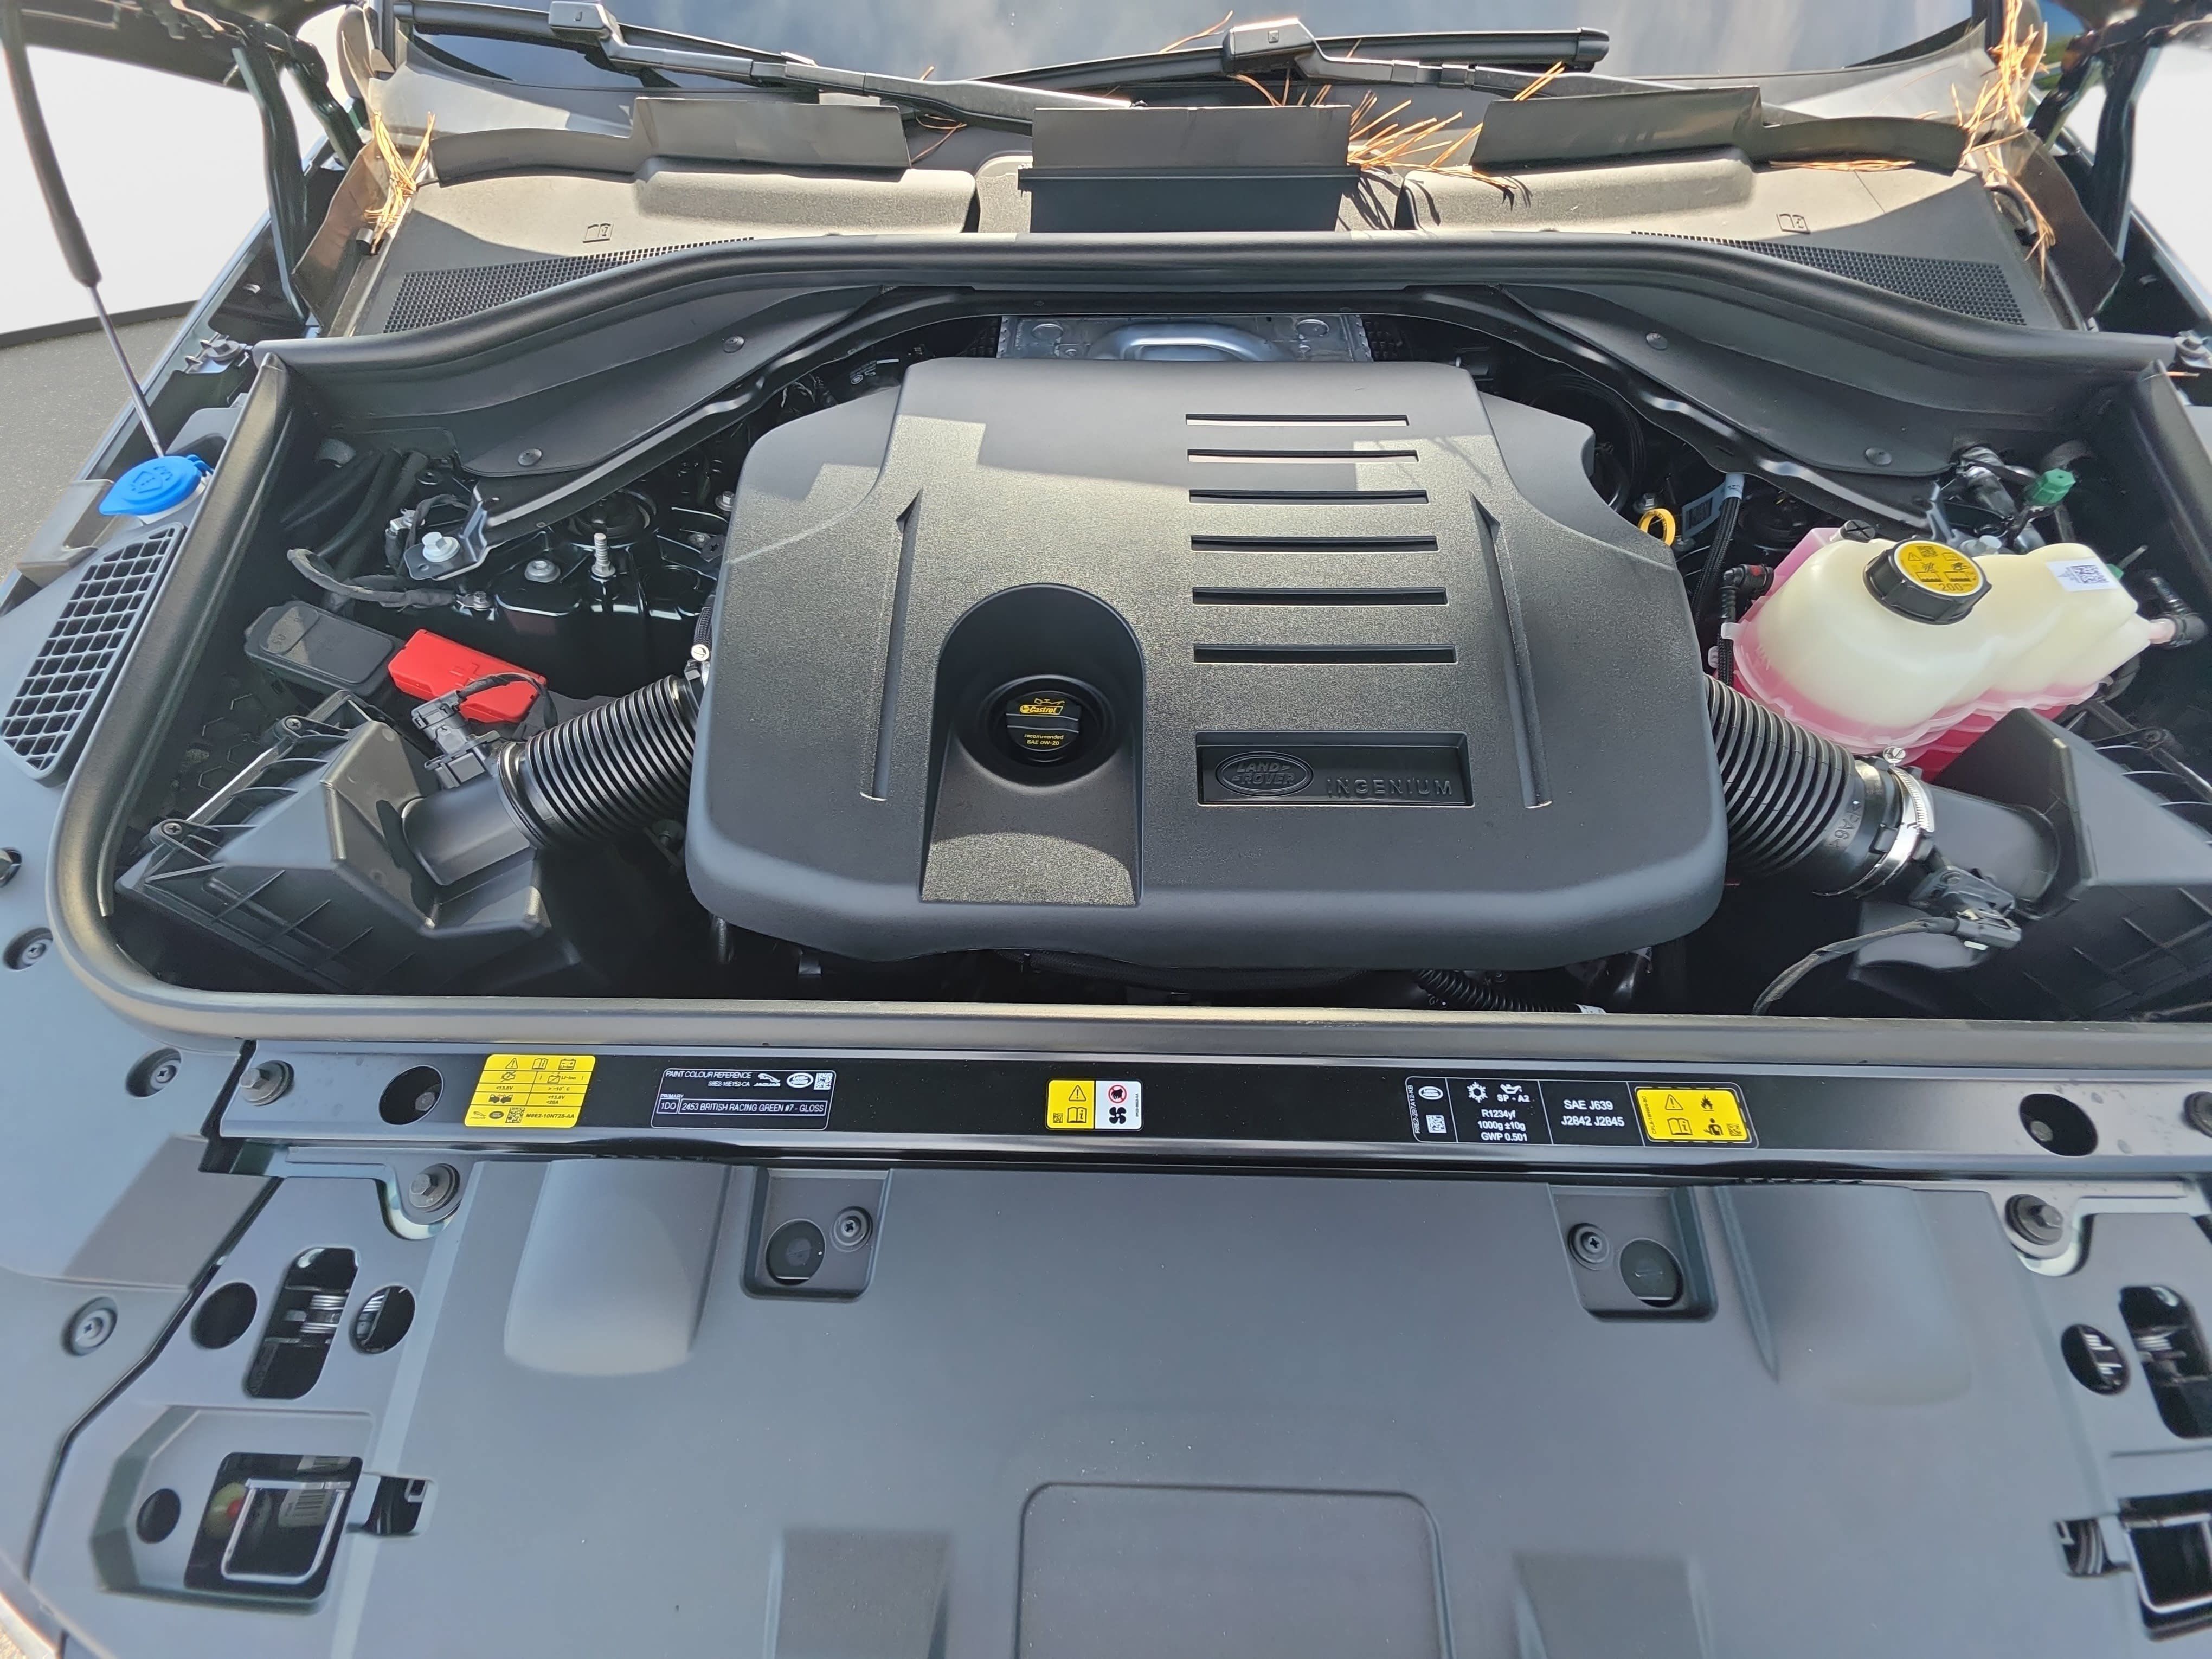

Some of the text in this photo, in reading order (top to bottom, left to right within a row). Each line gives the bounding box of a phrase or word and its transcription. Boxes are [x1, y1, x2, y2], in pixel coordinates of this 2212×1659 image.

[1938, 583, 1964, 591] 200
[1236, 761, 1279, 773] LAND
[1241, 772, 1295, 786] ROVER
[1326, 778, 1454, 797] INGENIUM
[681, 1102, 699, 1111] 2453
[700, 1103, 728, 1111] BRITISH
[729, 1103, 757, 1111] RACING
[758, 1104, 784, 1112] GREEN
[1563, 1099, 1614, 1110] SAE J639
[1481, 1109, 1516, 1120] R1234yf
[1477, 1120, 1504, 1131] 1000g
[1561, 1115, 1625, 1127] J2842 J2845
[1481, 1131, 1528, 1141] GWP 0.501
